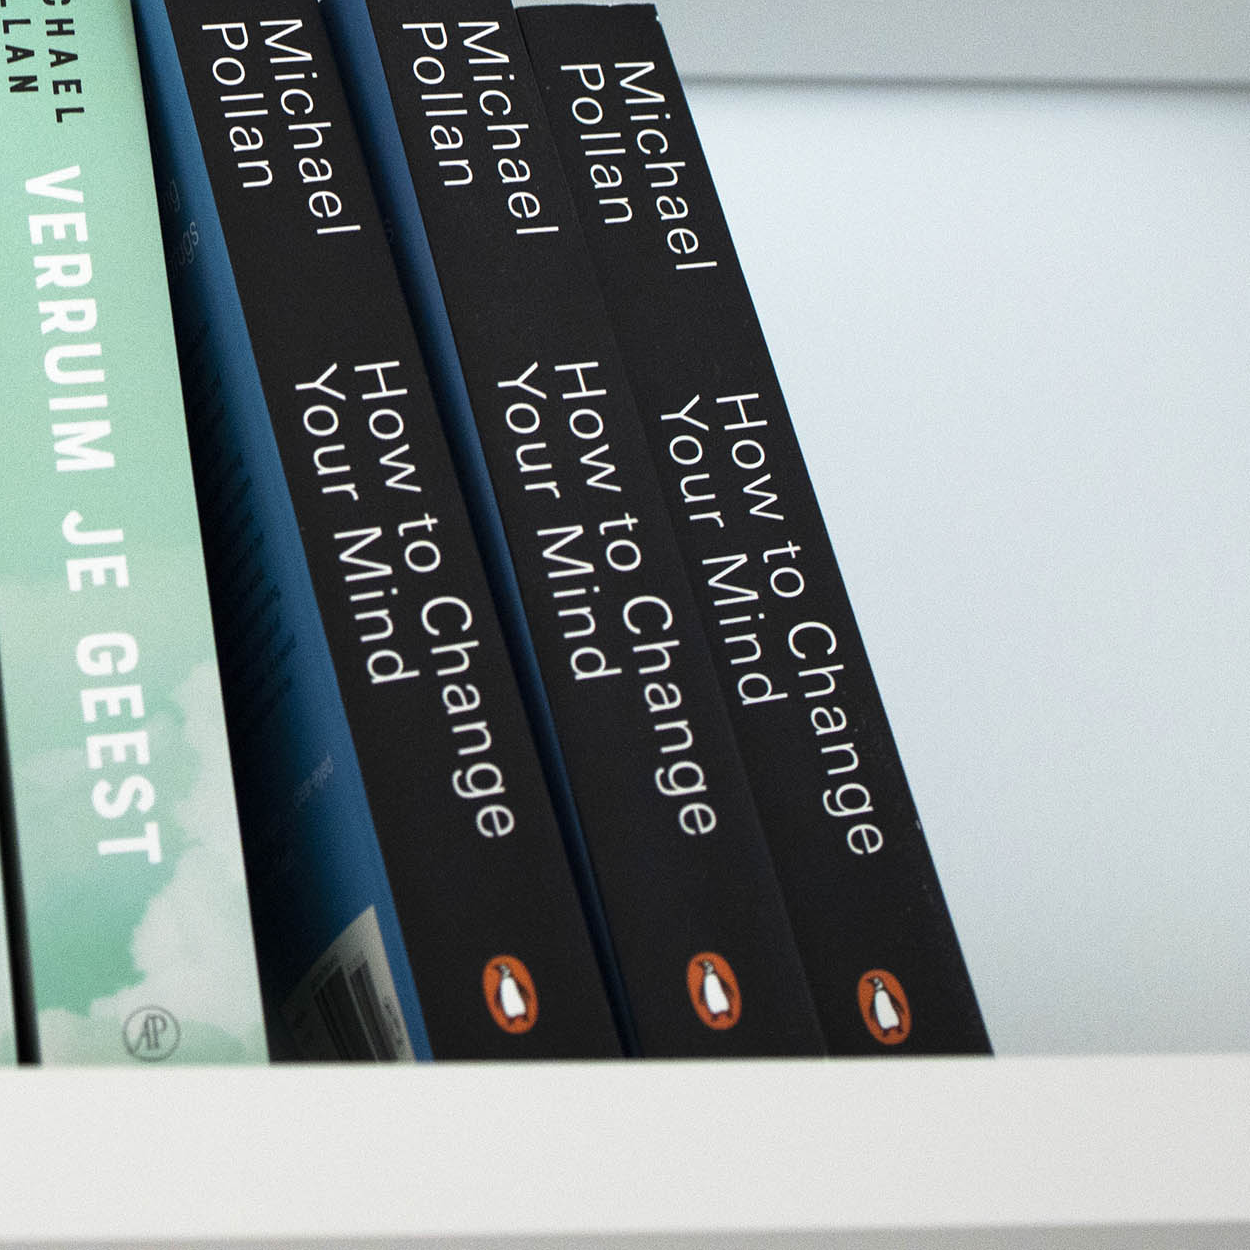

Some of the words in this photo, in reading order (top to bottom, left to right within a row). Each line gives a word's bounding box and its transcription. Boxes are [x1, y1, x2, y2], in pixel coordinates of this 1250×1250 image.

[201, 21, 275, 189] Pollan
[259, 18, 361, 236] Michael
[402, 21, 474, 187] Pollan
[458, 21, 560, 235] Michael
[560, 62, 634, 225] Pollan
[614, 61, 718, 271] Michael
[25, 165, 115, 473] VERRUIM
[61, 510, 129, 592] JE
[295, 362, 359, 501] Your
[333, 526, 420, 685] Mind
[354, 360, 422, 493] How
[397, 512, 441, 574] to
[421, 595, 515, 839] Change
[497, 361, 561, 500] Your
[536, 524, 623, 681] Mind
[554, 361, 622, 492] How
[599, 512, 639, 572] to
[622, 593, 718, 837] Change
[660, 394, 725, 529] Your
[702, 553, 788, 707] Mind
[716, 393, 785, 521] How
[762, 541, 802, 599] to
[788, 620, 884, 855] Change
[75, 631, 162, 865] GEEST
